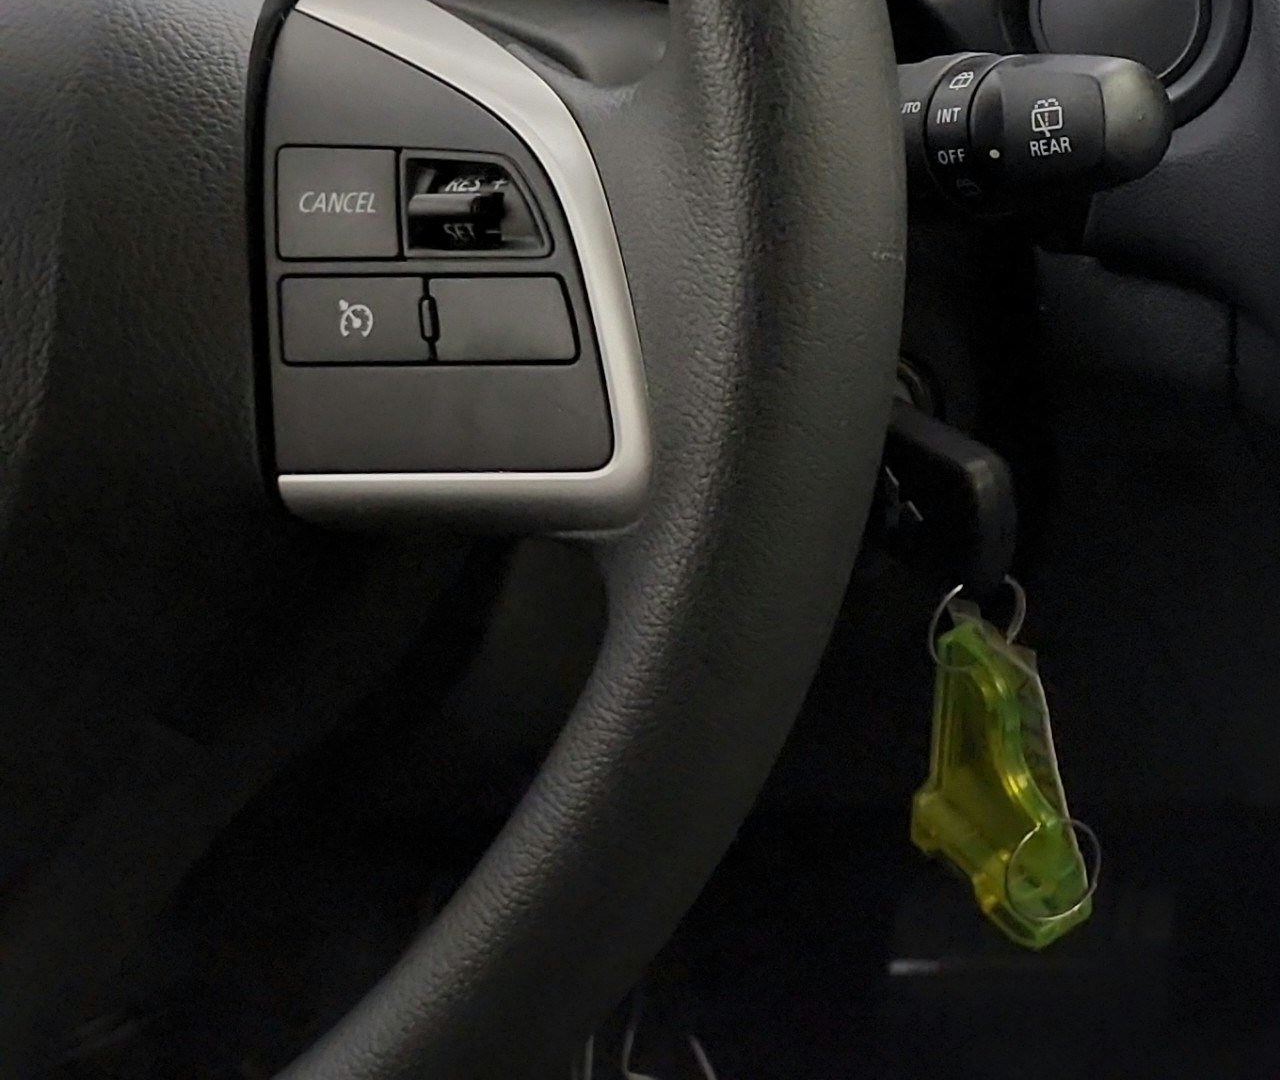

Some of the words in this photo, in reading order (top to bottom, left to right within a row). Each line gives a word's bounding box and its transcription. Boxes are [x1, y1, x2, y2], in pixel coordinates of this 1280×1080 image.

[901, 101, 922, 114] TO
[936, 107, 962, 125] INT
[1029, 136, 1073, 157] REAR
[937, 148, 966, 166] OFF
[299, 191, 377, 215] CANCEL
